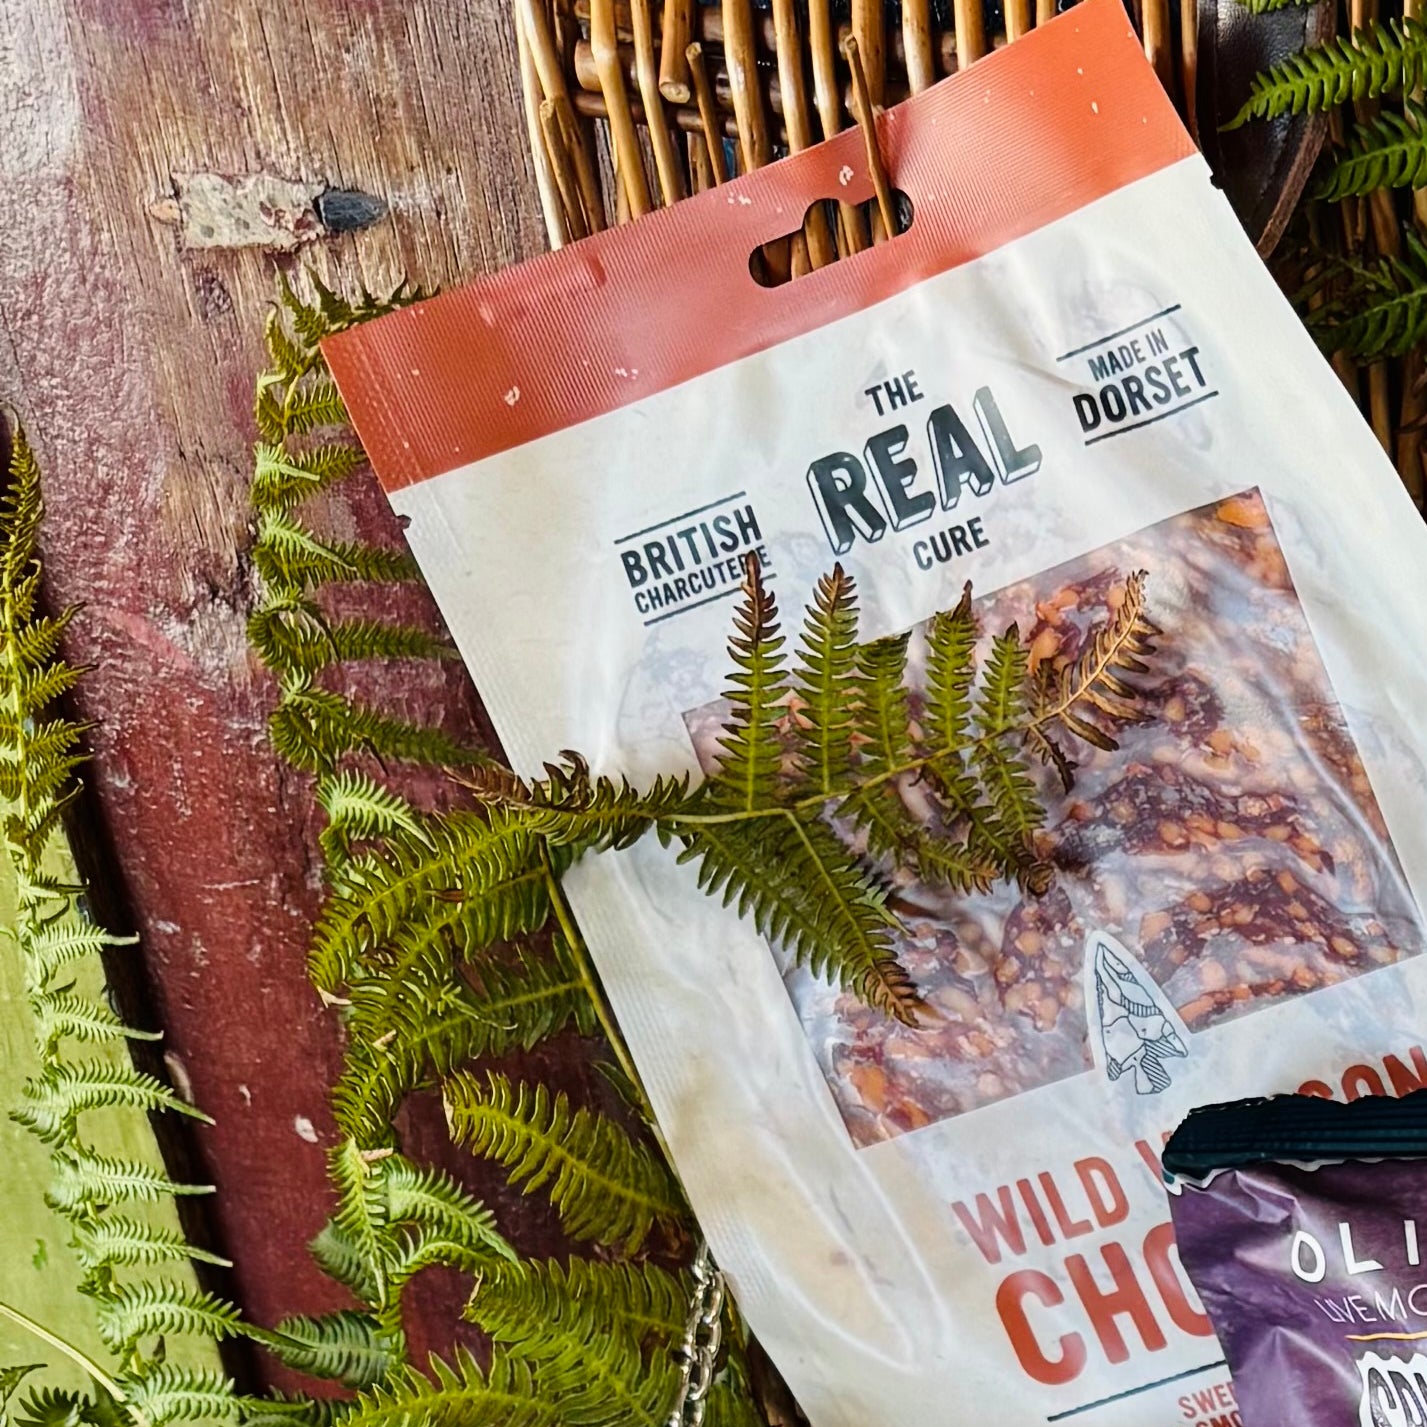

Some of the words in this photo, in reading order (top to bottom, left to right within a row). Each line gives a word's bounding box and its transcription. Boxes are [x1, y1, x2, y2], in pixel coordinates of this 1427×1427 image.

[865, 371, 924, 417] THE
[1073, 347, 1208, 432] DORSET
[1088, 341, 1146, 381] MADE
[1148, 329, 1169, 357] IN
[807, 386, 1043, 556] REAL
[620, 505, 763, 588] BRITISH
[913, 517, 990, 570] CURE
[952, 1156, 1131, 1264] WILD
